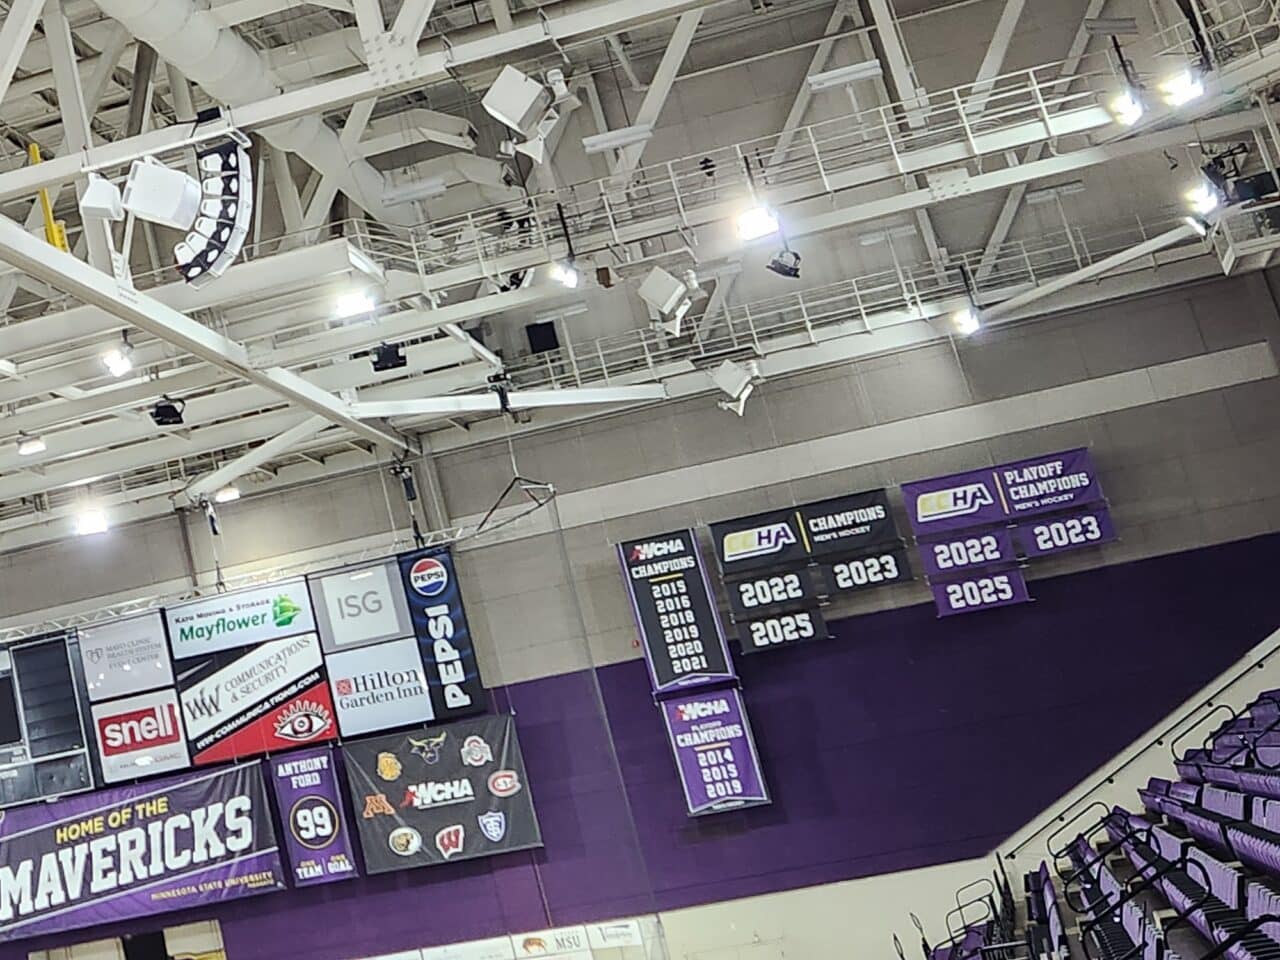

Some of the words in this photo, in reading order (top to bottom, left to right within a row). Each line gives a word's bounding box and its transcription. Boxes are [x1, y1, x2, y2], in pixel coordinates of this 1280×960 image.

[1004, 461, 1063, 485] PLAYOFF
[1009, 472, 1089, 501] CHAMPIONS
[1040, 493, 1074, 507] HOCKEY
[808, 505, 886, 532] CHAMPIONS
[838, 525, 871, 538] HOCKEY
[1033, 515, 1101, 550] 2023
[634, 539, 685, 560] WCHA
[934, 535, 1000, 569] 2022
[414, 570, 444, 584] PEPSI
[631, 555, 696, 579] CHAMPIONS
[833, 555, 899, 589] 2023
[652, 580, 687, 598] 2015
[739, 574, 803, 608] 2022
[946, 576, 1013, 609] 2025
[337, 591, 383, 620] ISG
[655, 595, 690, 613] 2016
[179, 612, 268, 642] Mayflower
[659, 610, 694, 628] 2018
[750, 613, 814, 647] 2025
[664, 625, 699, 643] 2019
[425, 604, 471, 709] PEPSI
[668, 640, 703, 658] 2020
[224, 637, 311, 692] COMMUNICATIONS
[672, 655, 707, 673] 2021
[241, 665, 288, 698] SECURITY
[352, 668, 420, 694] Hilton
[339, 689, 395, 710] Garden
[398, 685, 425, 699] Inn
[677, 699, 730, 721] WCHA
[104, 705, 173, 747] snell
[676, 724, 743, 748] CHAMPIONS
[277, 756, 329, 777] ANTHONY
[697, 748, 734, 767] 2014
[291, 772, 321, 790] FORD
[701, 763, 738, 783] 2015
[406, 778, 474, 807] WCHA
[705, 779, 743, 798] 2019
[56, 815, 105, 845] HOME
[108, 808, 133, 829] OF
[136, 797, 169, 820] THE
[296, 806, 333, 840] 99
